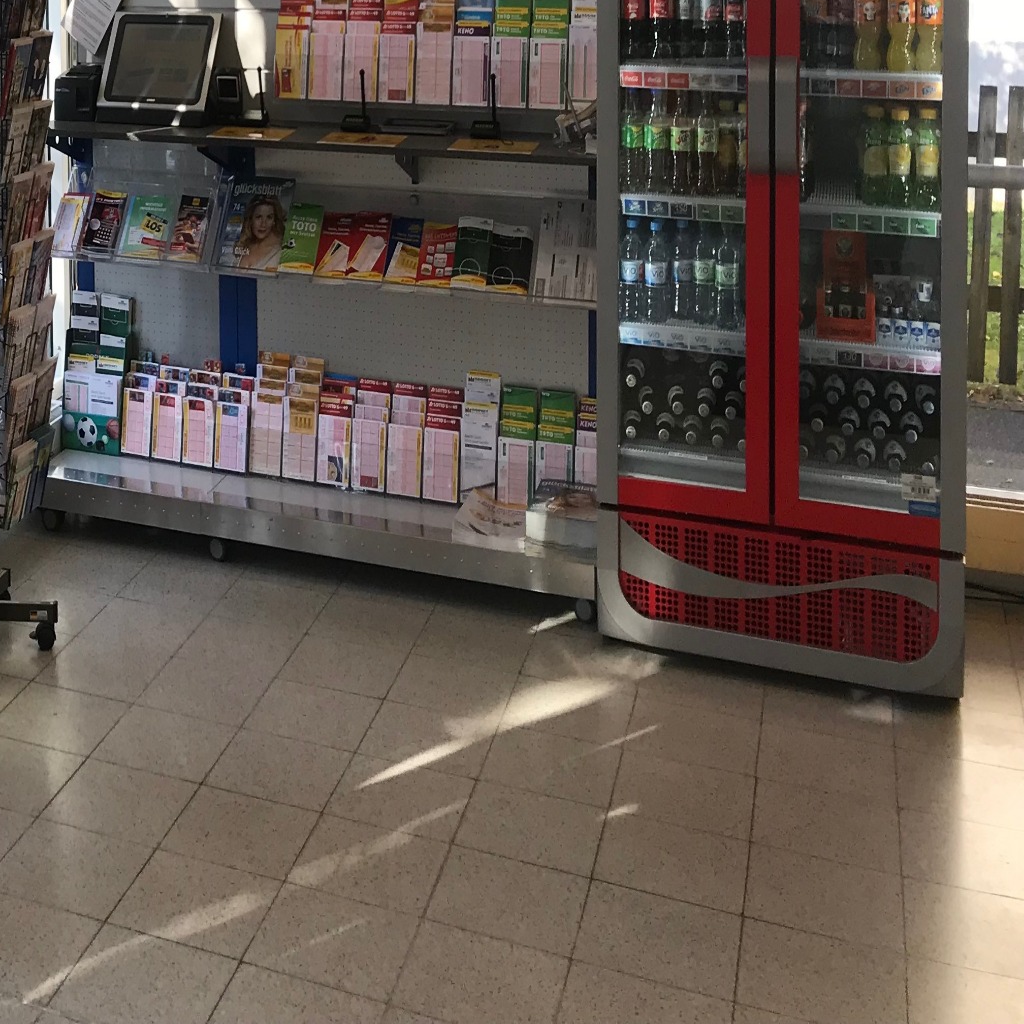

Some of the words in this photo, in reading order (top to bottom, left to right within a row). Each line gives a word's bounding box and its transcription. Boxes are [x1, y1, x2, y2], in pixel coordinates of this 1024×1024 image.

[233, 182, 282, 197] glücksblatt
[145, 219, 163, 233] LOS
[291, 220, 318, 232] TOTO
